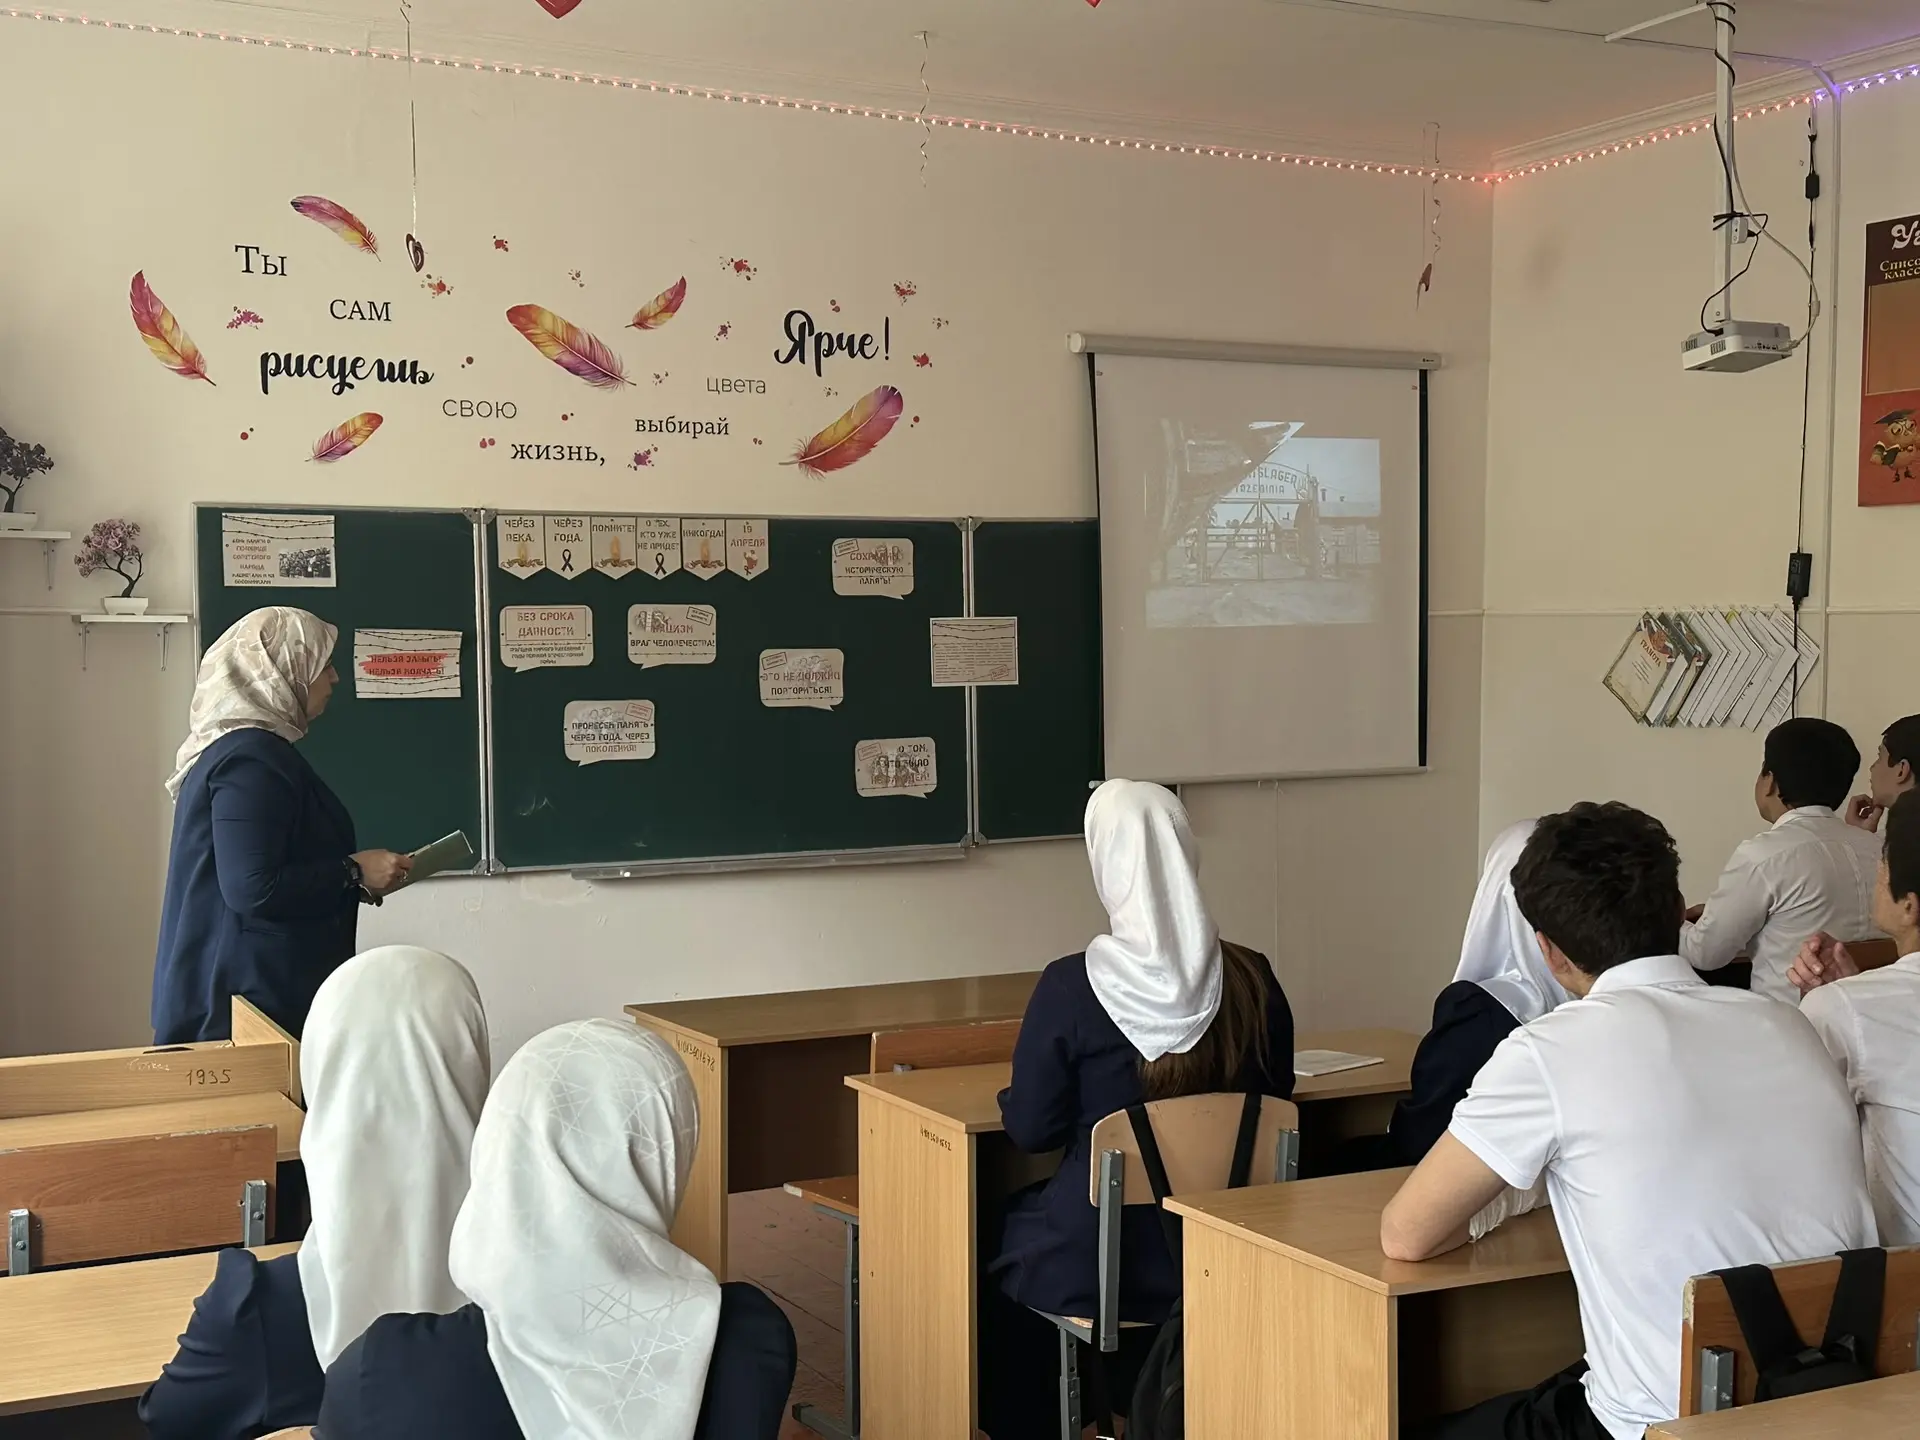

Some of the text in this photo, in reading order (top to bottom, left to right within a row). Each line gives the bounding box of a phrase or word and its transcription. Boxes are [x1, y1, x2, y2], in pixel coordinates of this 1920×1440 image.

[235, 245, 288, 276] Ты
[774, 310, 890, 377] Ярче!
[261, 350, 434, 395] рисуешь
[706, 377, 766, 394] цвета
[635, 415, 729, 439] выбирай
[511, 444, 605, 466] жизнь,
[505, 519, 535, 528] ЧЕРЕЗ
[553, 519, 583, 528] ЧЕРЕЗ
[743, 525, 753, 533] 19
[640, 531, 677, 539] КТО УЖЕ
[730, 538, 766, 547] АПРЕЛЯ
[517, 612, 574, 621] БЕЗ СРОКА
[518, 627, 574, 638] ДАВНОСТИ
[571, 733, 596, 741] ЧЕРЕЗ
[625, 732, 650, 740] ЧЕРЕЗ
[185, 1069, 231, 1086] 1935
